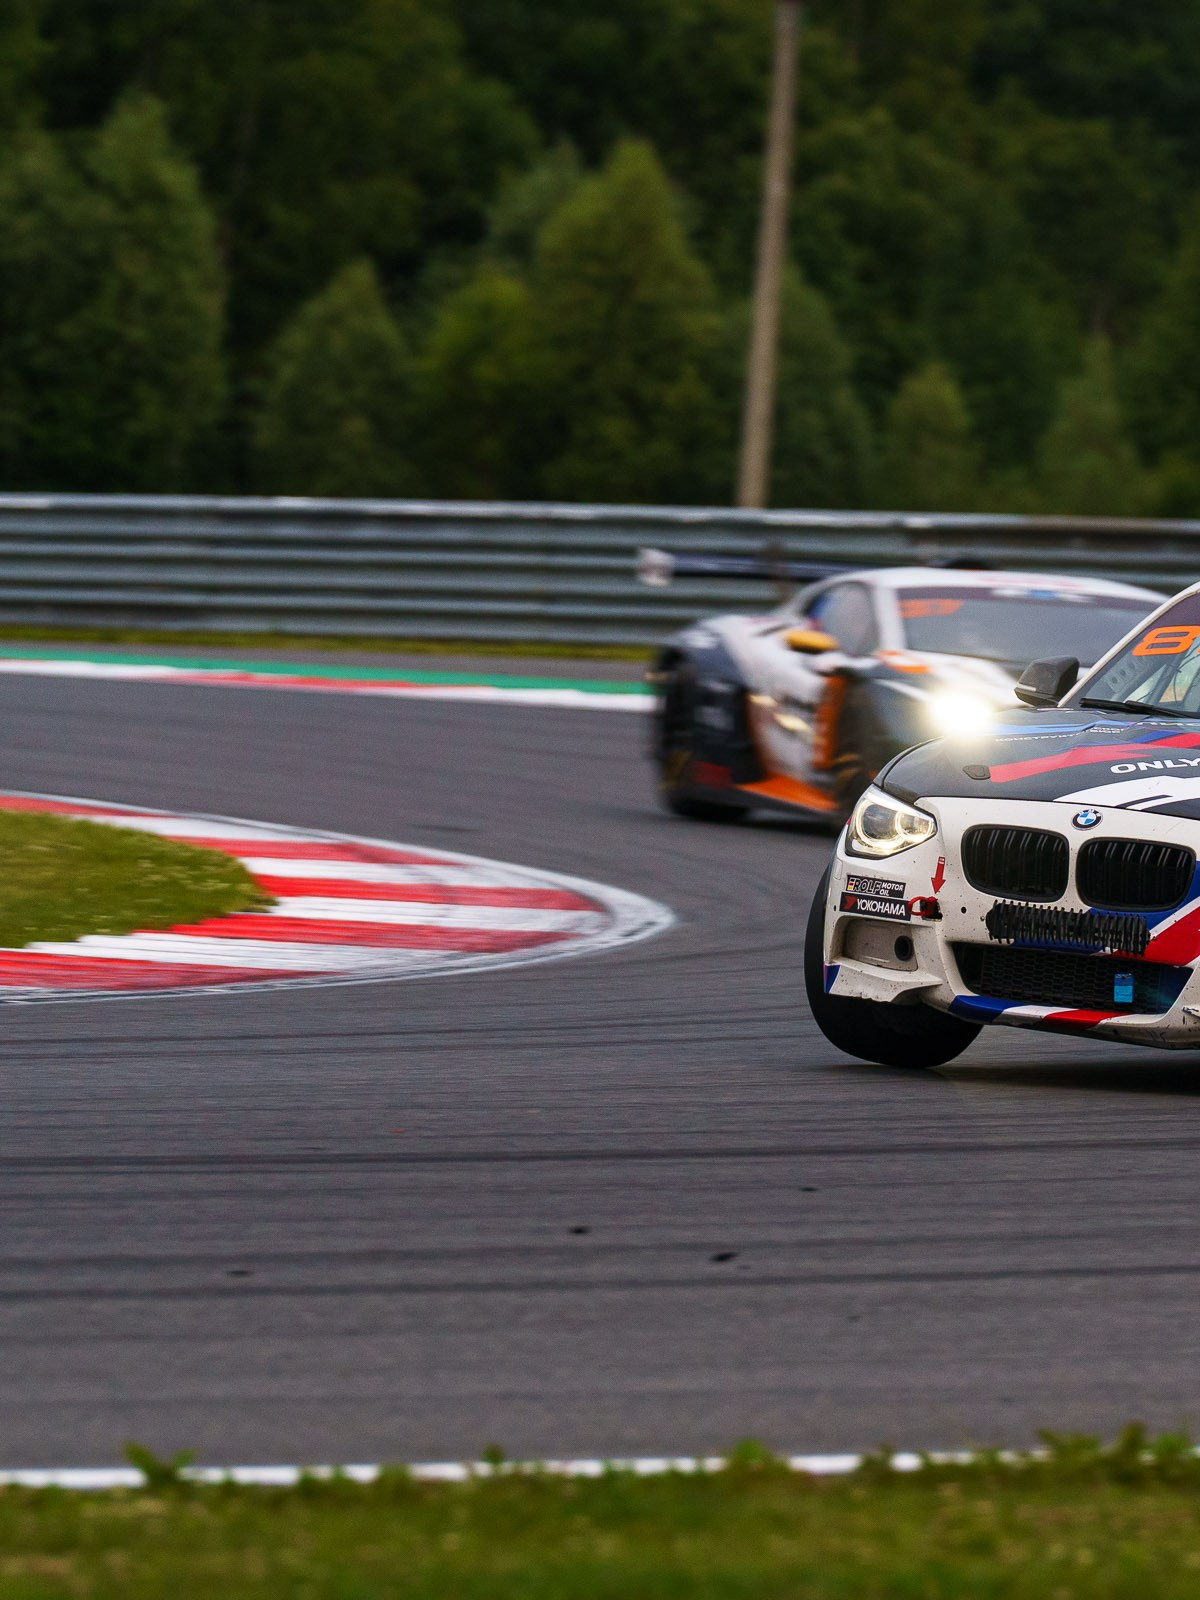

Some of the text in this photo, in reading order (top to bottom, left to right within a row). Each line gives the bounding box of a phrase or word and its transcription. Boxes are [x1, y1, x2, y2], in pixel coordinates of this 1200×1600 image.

[852, 878, 904, 896] ROLF MOTOR
[879, 889, 889, 898] OIL
[856, 898, 906, 917] YOKOHAMA
